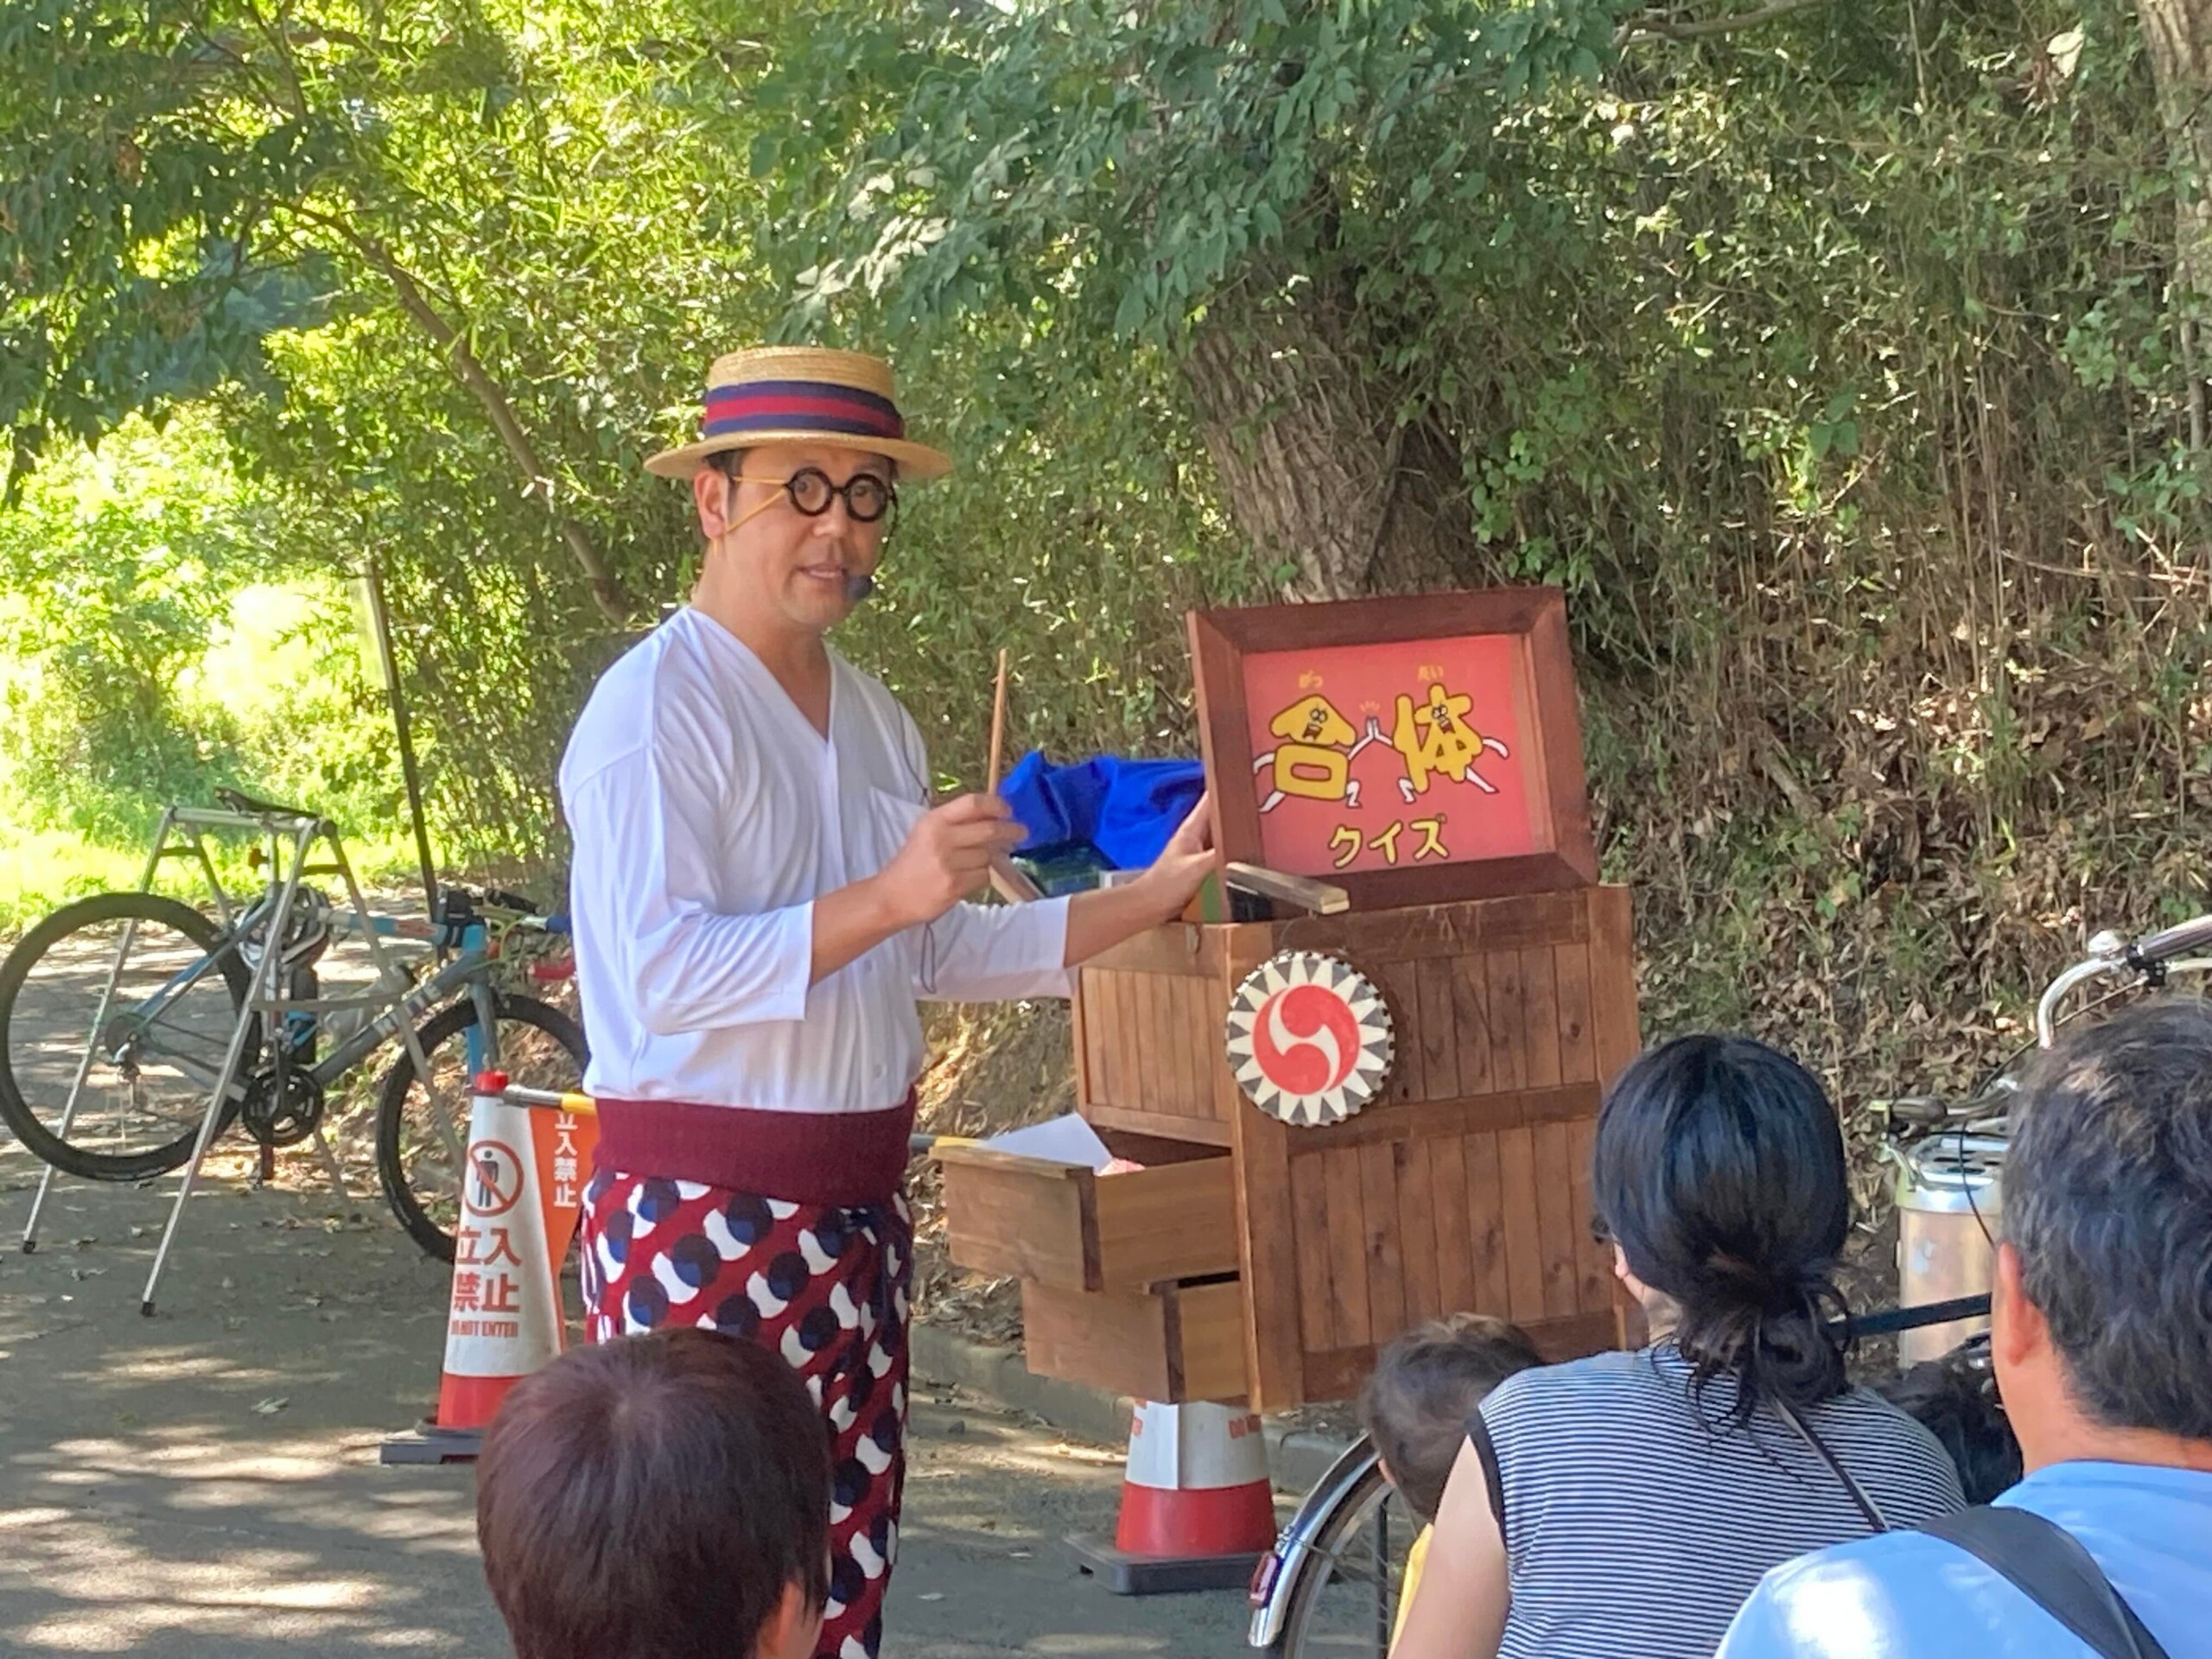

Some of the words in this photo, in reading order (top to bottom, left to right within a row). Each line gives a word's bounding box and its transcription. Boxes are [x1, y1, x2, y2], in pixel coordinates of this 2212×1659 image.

[1269, 683, 1484, 801] 合体
[1328, 813, 1450, 869] クイズ
[456, 1226, 522, 1267] 立入
[454, 1272, 520, 1313] 禁止
